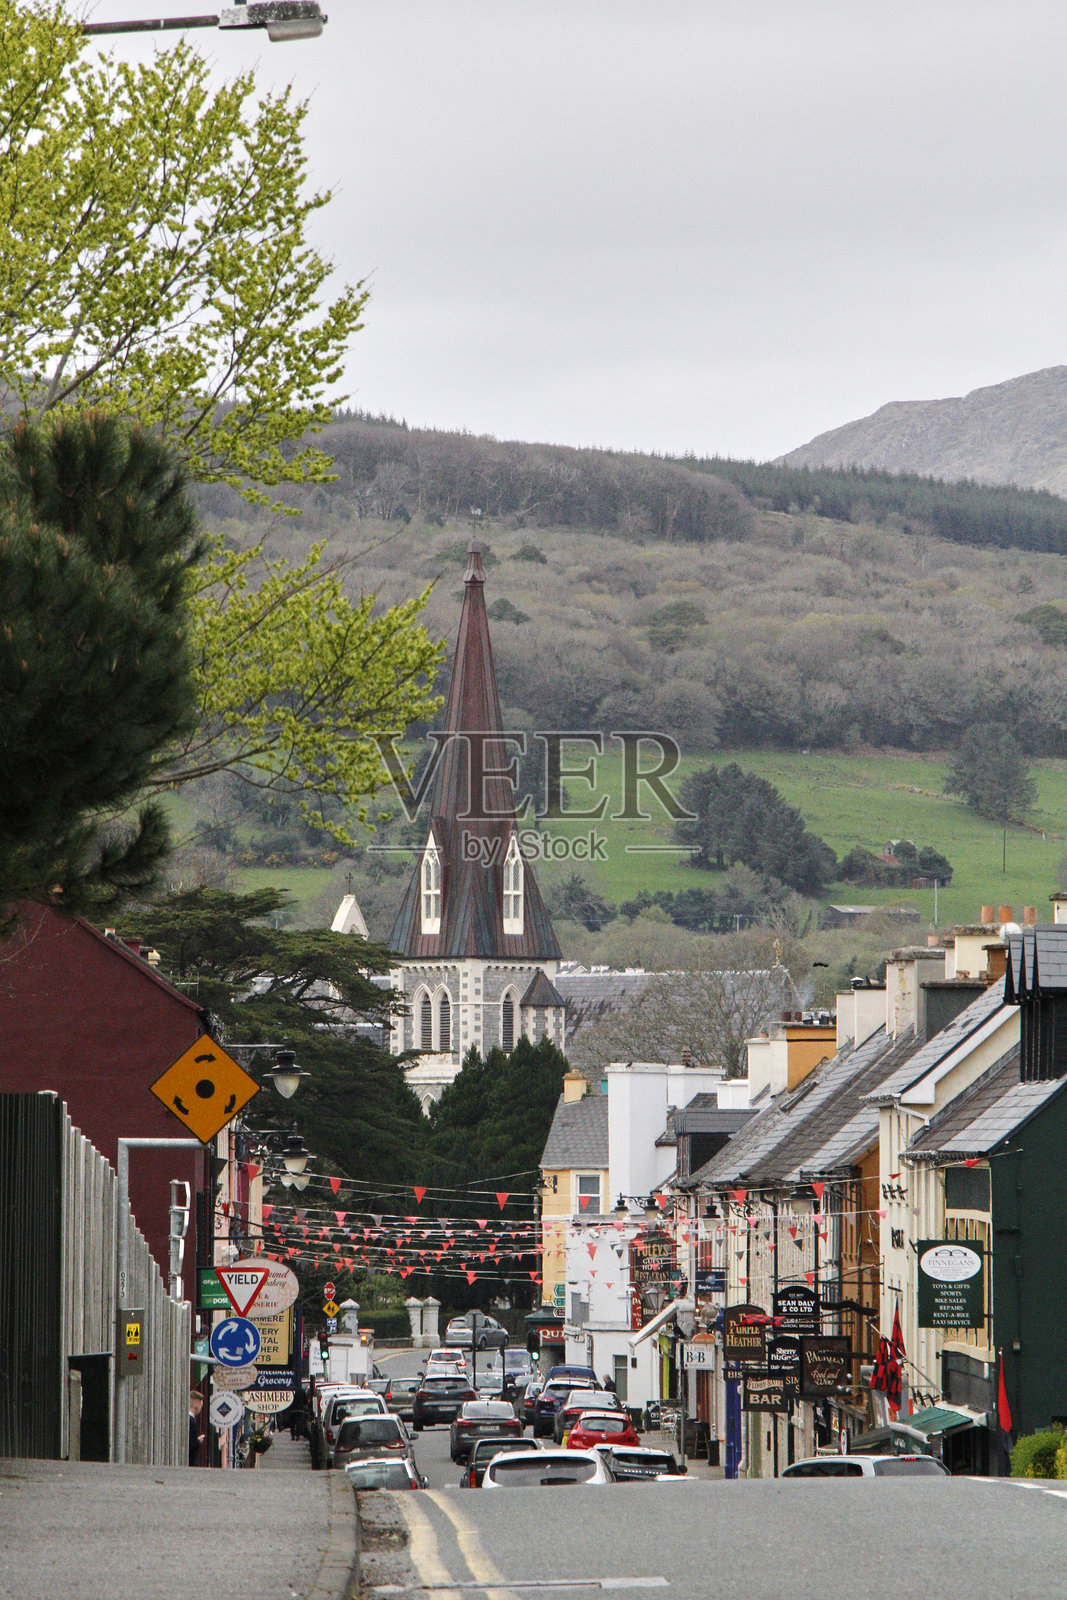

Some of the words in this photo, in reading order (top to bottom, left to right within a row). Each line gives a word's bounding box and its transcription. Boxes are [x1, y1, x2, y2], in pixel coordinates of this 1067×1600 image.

[227, 1274, 259, 1285] YIELD
[258, 1327, 279, 1335] TERY
[729, 1320, 760, 1335] PURPLE
[540, 1329, 565, 1339] QUI
[726, 1334, 762, 1347] HEATHER
[727, 1371, 743, 1379] BIS
[826, 1368, 841, 1379] and
[257, 1375, 293, 1387] Grocery
[249, 1391, 291, 1402] ASHMERE
[749, 1394, 781, 1405] BAR
[257, 1403, 279, 1411] SHOP
